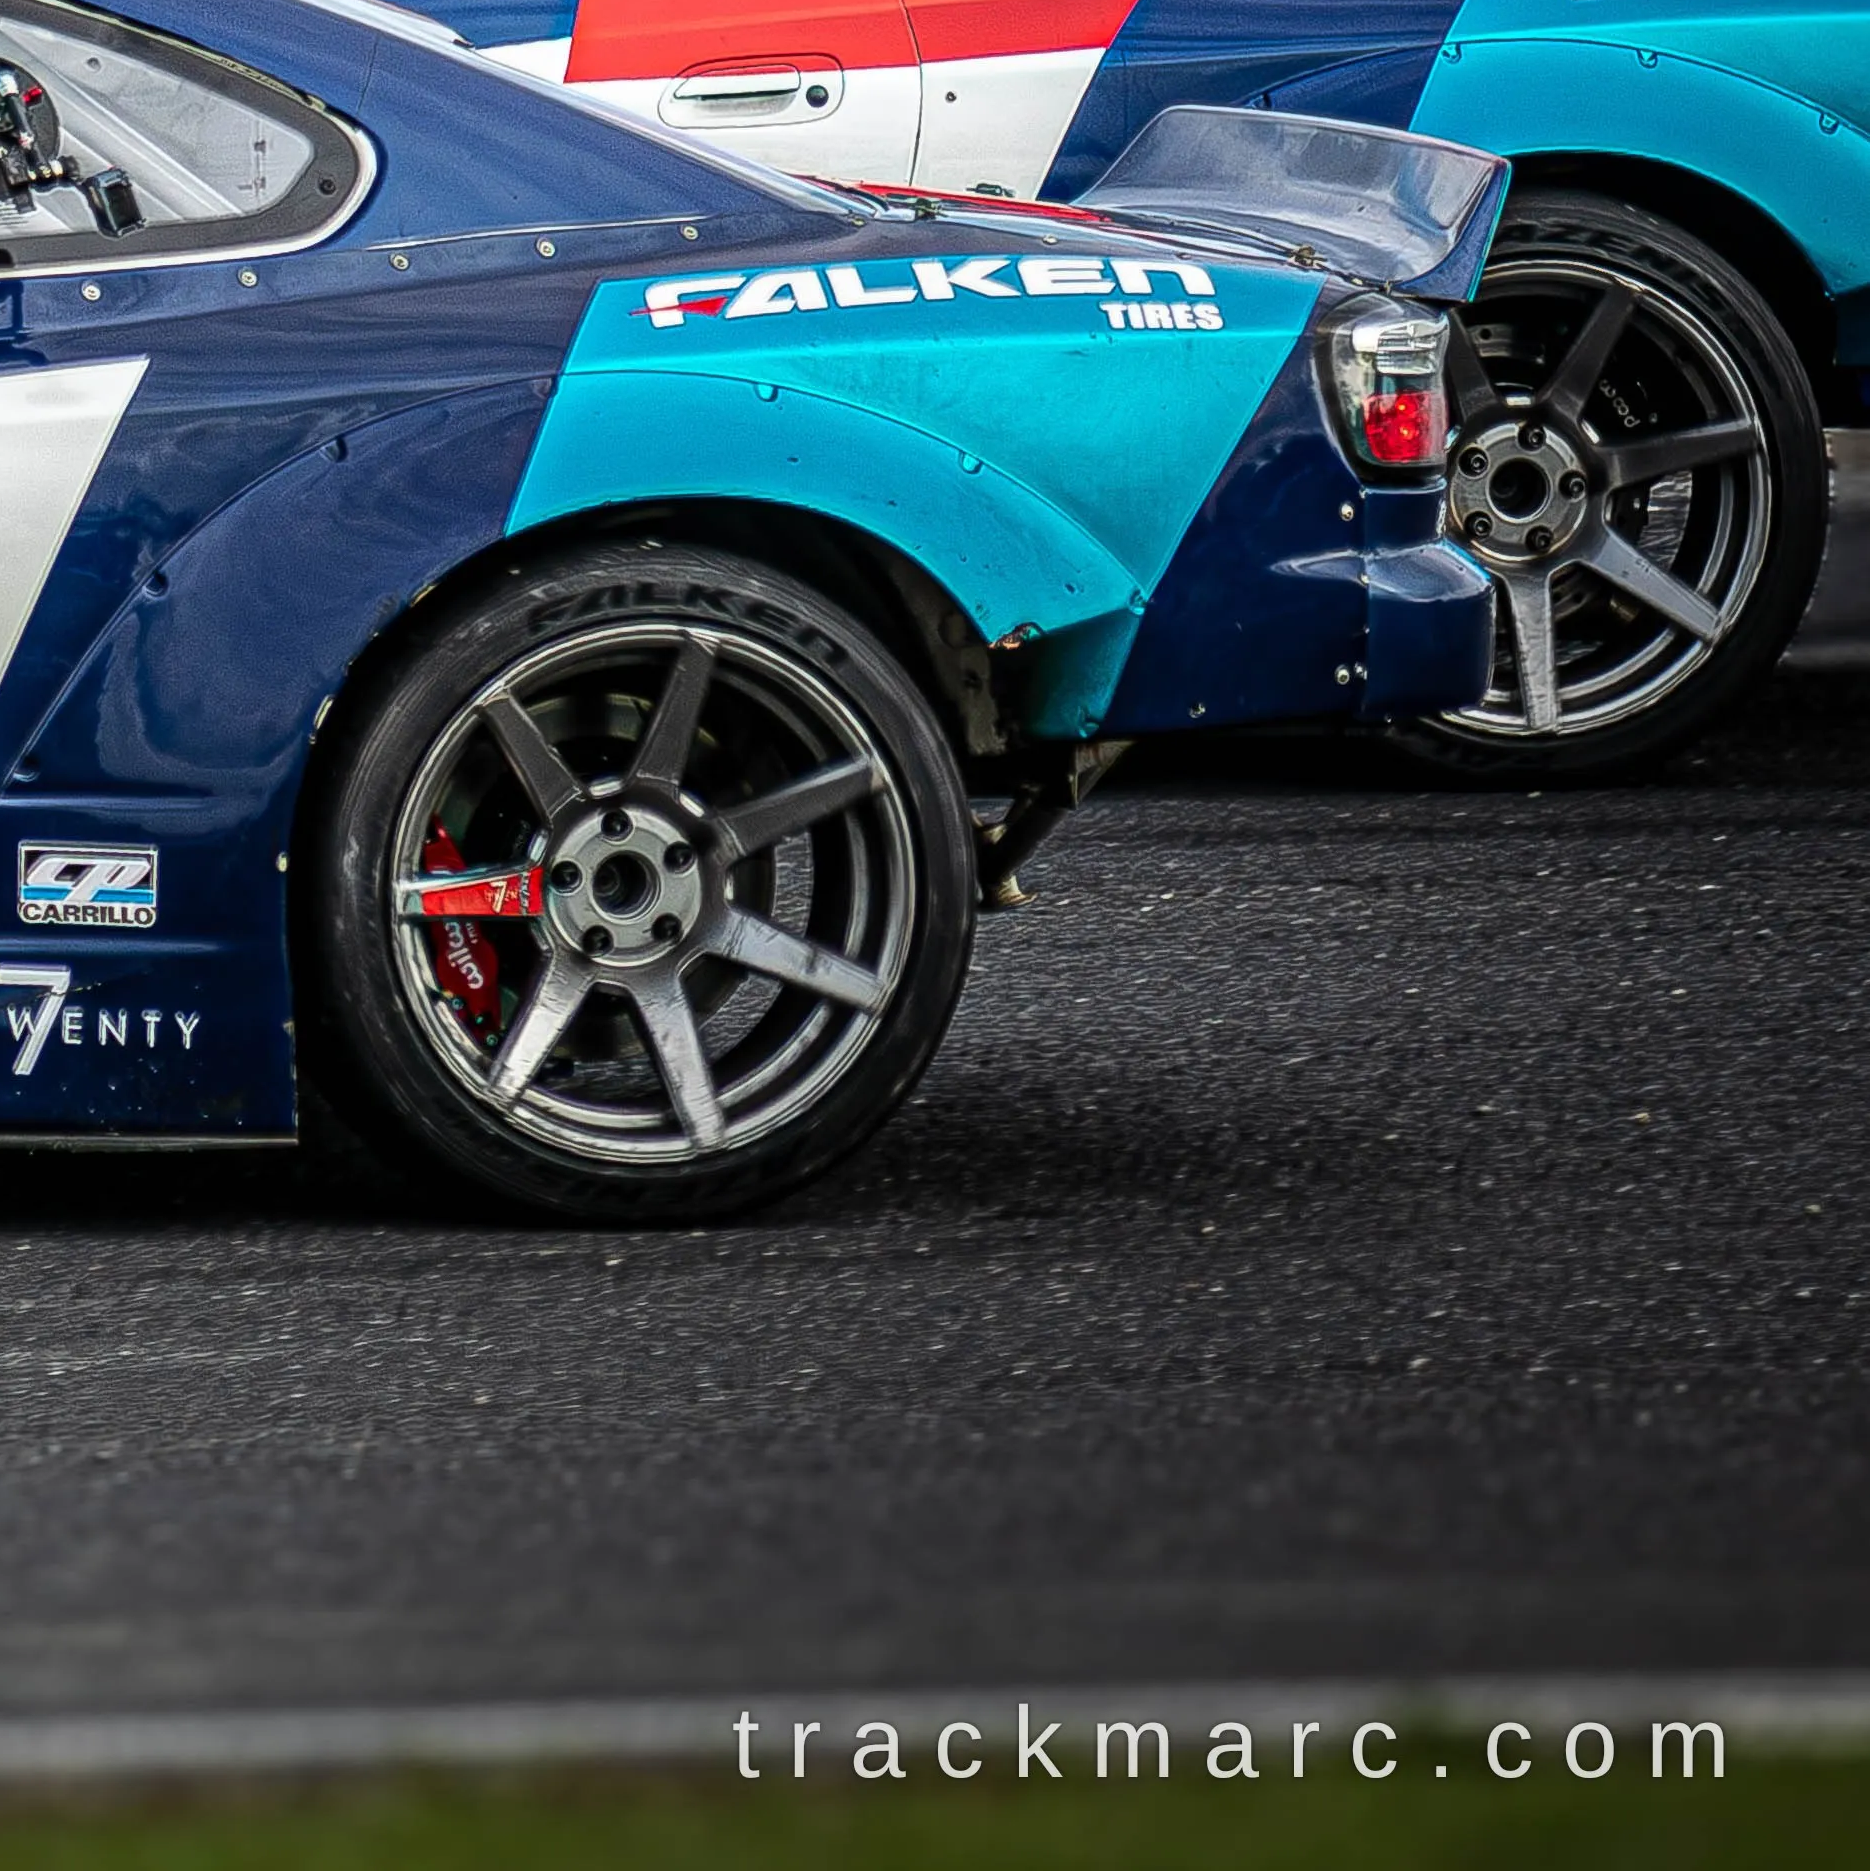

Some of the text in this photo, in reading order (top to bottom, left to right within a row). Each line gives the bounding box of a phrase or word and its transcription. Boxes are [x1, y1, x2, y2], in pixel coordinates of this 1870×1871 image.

[639, 254, 1217, 330] FALKEN
[1100, 302, 1224, 331] TIRES
[22, 903, 155, 925] CARRILLO
